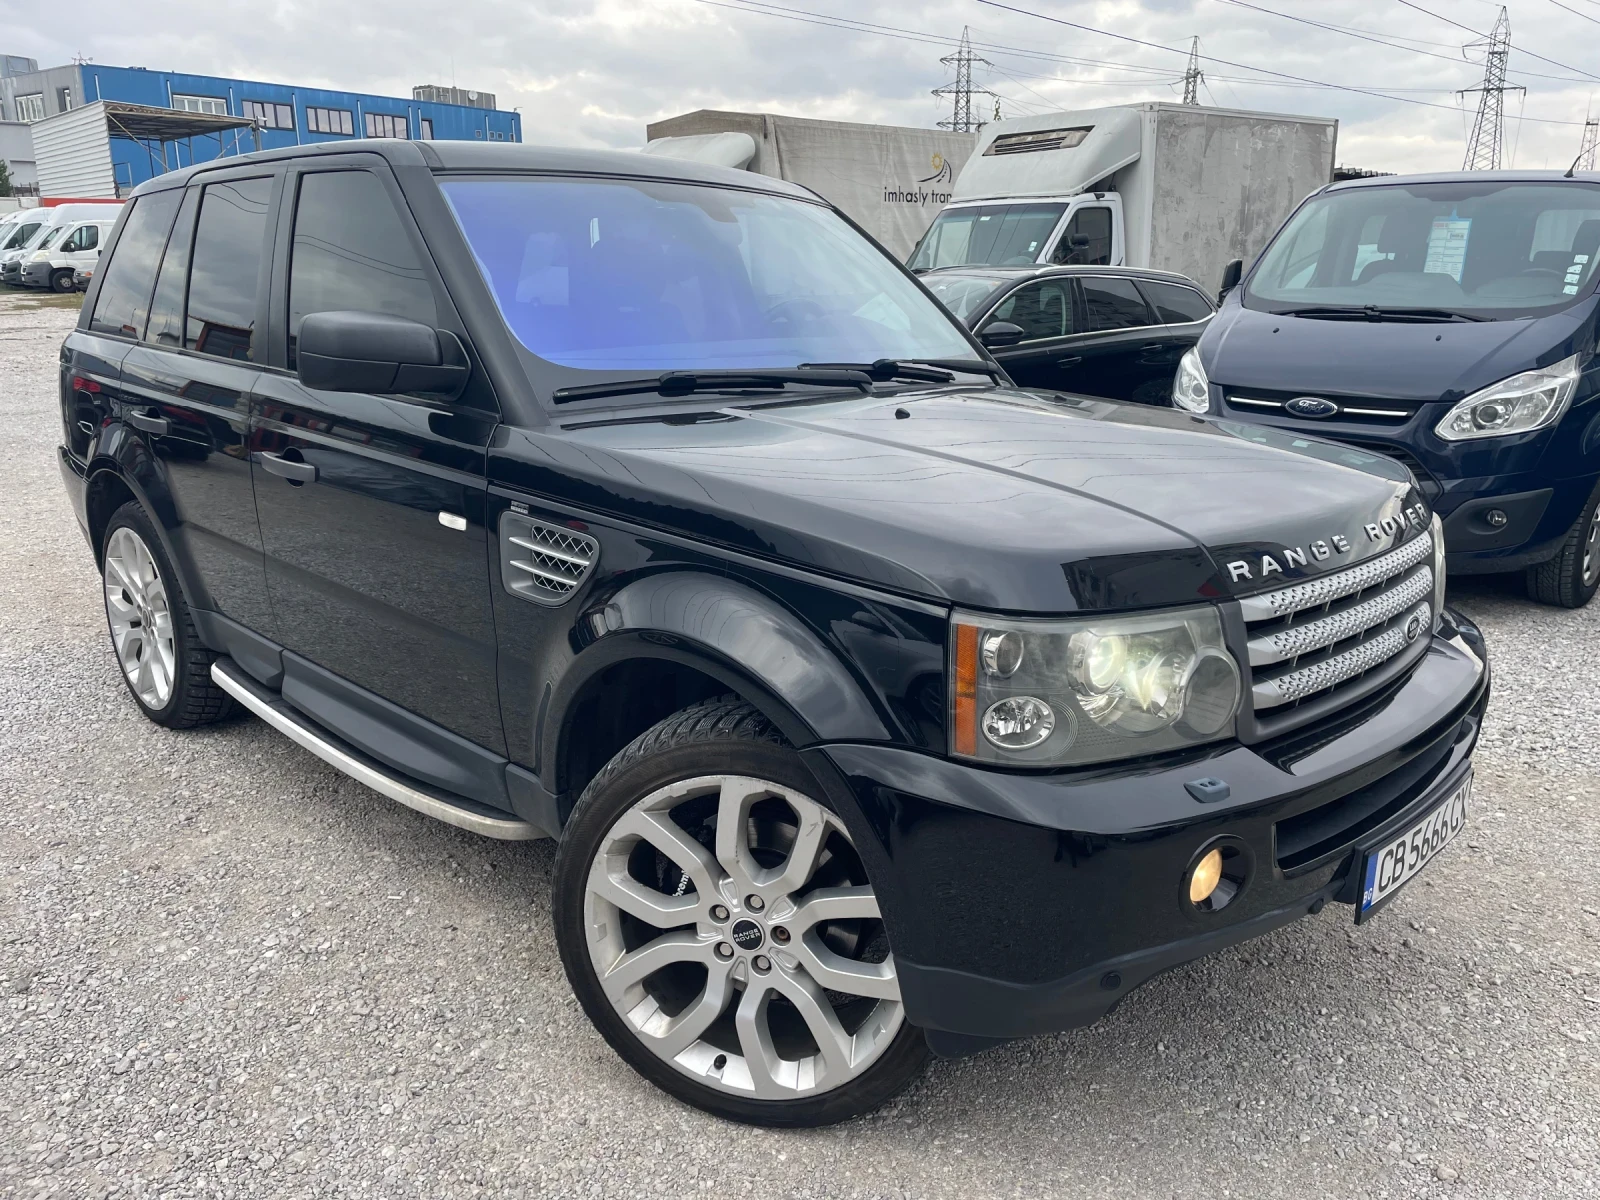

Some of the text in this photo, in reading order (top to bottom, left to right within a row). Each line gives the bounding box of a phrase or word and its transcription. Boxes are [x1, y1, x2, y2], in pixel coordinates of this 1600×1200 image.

[884, 185, 928, 208] imhasly
[1296, 399, 1325, 412] Ford
[1226, 503, 1427, 583] RANGE ROVER
[1408, 802, 1449, 871] 5666
[733, 928, 759, 938] RANGE
[735, 933, 761, 943] ROVER
